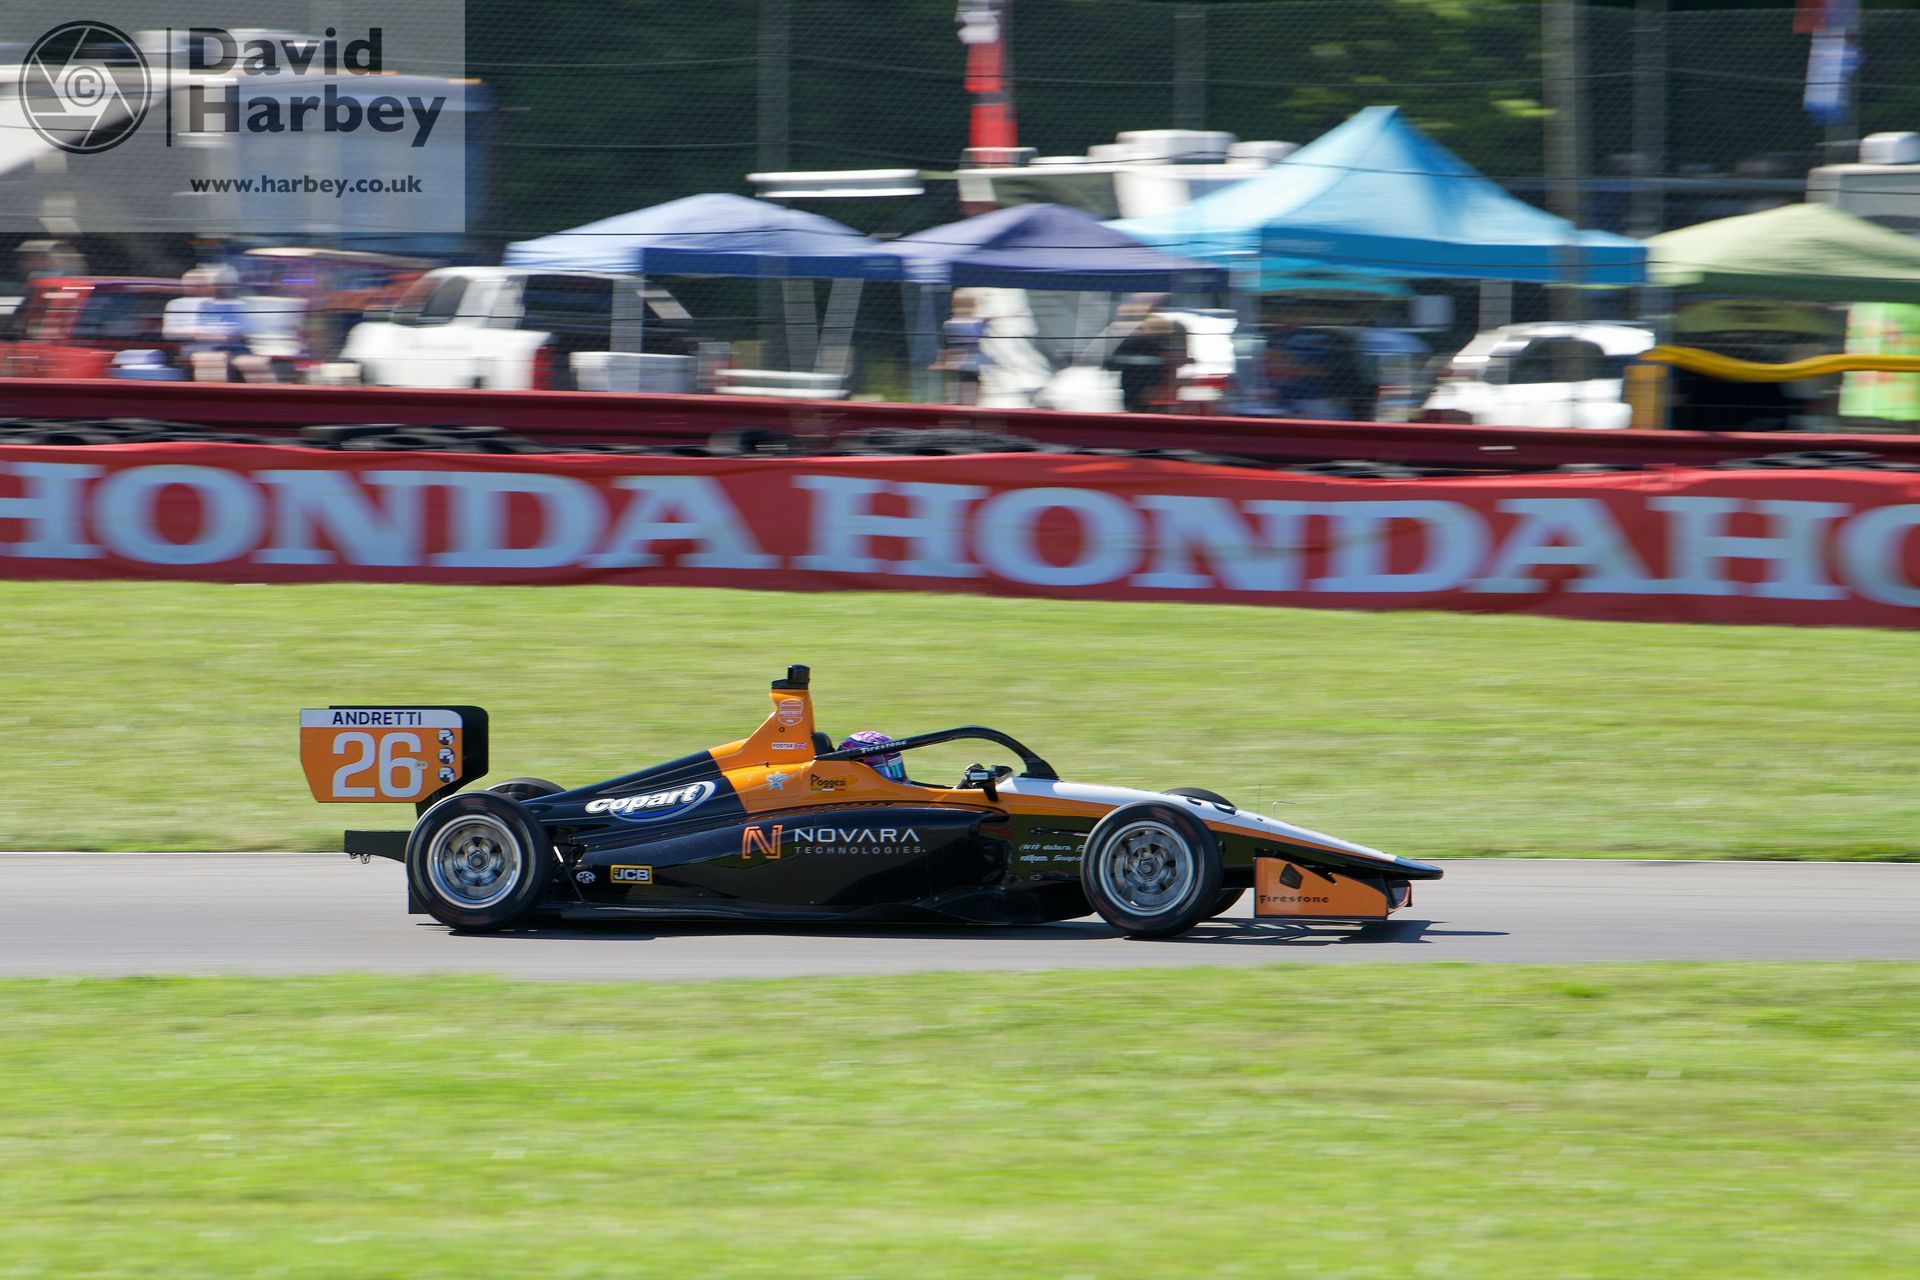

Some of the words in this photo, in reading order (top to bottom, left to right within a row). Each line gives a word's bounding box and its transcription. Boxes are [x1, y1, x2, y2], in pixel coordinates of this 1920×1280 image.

[792, 475, 1655, 594] HONDA
[332, 711, 422, 725] ANDRETTI
[861, 740, 908, 754] Firestone
[332, 731, 423, 798] 26
[585, 784, 701, 815] Copart
[794, 828, 920, 843] NOVARA
[614, 869, 649, 881] JCB
[1259, 895, 1329, 904] Firestone
